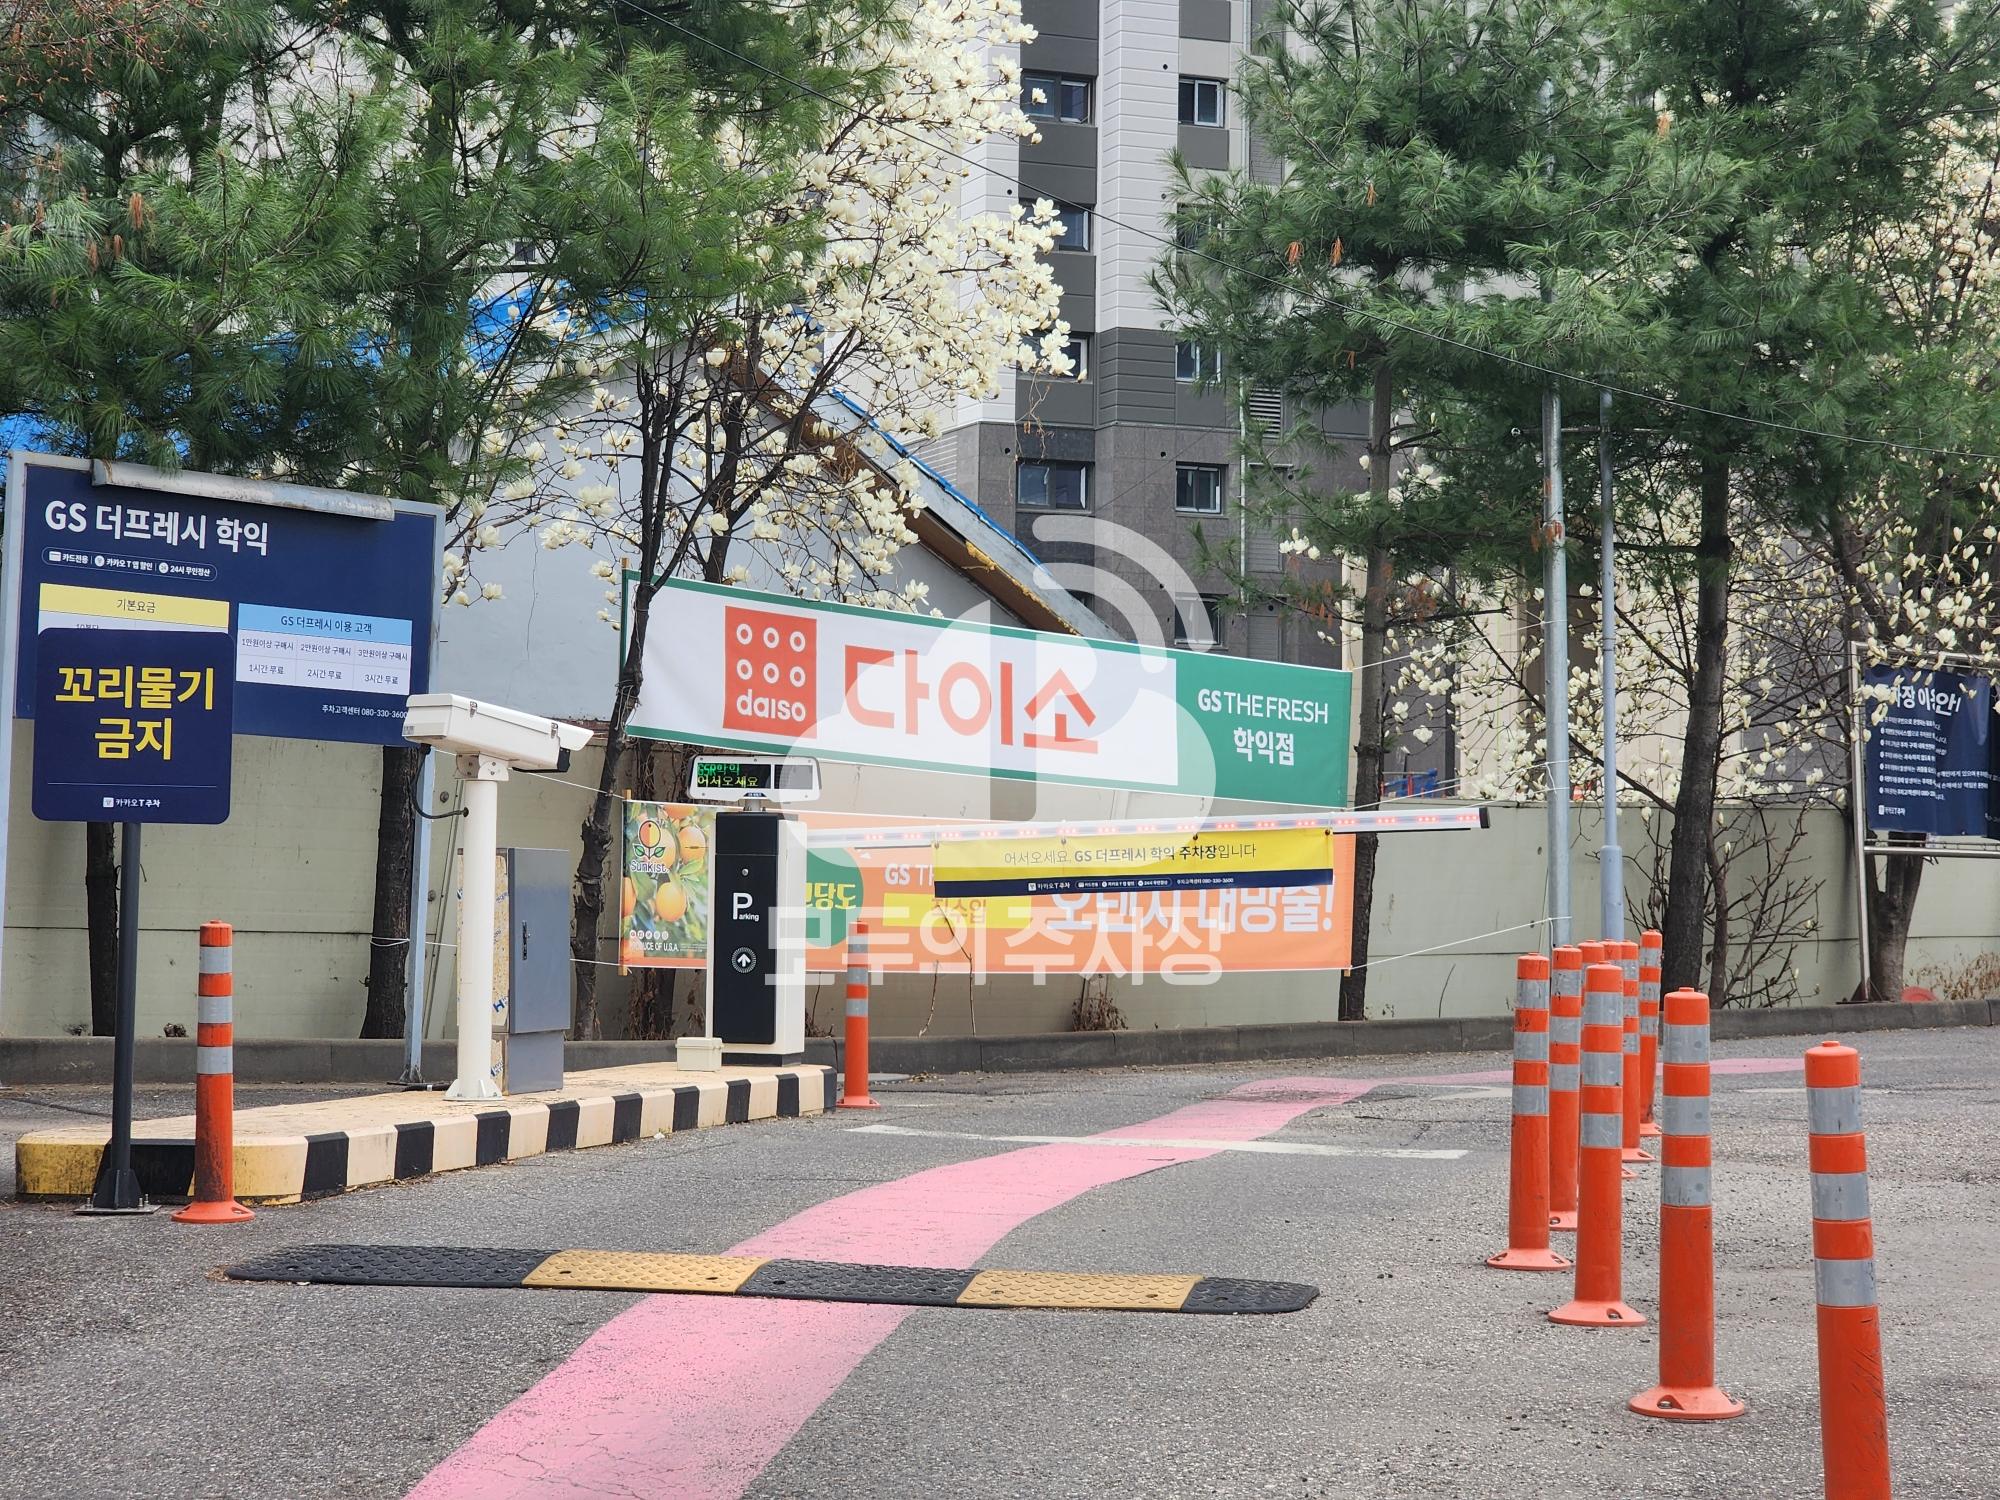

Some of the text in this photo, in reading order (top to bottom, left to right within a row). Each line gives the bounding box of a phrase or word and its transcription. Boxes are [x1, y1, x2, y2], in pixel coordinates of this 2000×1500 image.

[45, 500, 268, 556] GS 더프레시 학익
[117, 598, 156, 613] 기본요금
[281, 615, 372, 634] GS 더프레시 이용 고객
[242, 638, 272, 649] 1만원이상
[301, 643, 330, 654] 2만원이상
[358, 649, 388, 660] 3만원이상
[249, 664, 284, 675] 1시간 무료
[308, 669, 342, 680] 2시간 무료
[55, 665, 214, 710] 꼬리물기
[365, 674, 399, 685] 3시간 무료
[736, 688, 806, 722] daiso
[844, 644, 1099, 755] 다이소
[94, 717, 172, 761] 금지
[1233, 726, 1295, 766] 학익점
[697, 775, 759, 788] 어서오세요
[1074, 850, 1092, 862] GS
[1095, 847, 1147, 862] 더프레시
[1150, 845, 1176, 861] 학익
[1179, 843, 1257, 861] 주차장입니다
[630, 860, 667, 874] Sunkist
[884, 863, 911, 885] GS
